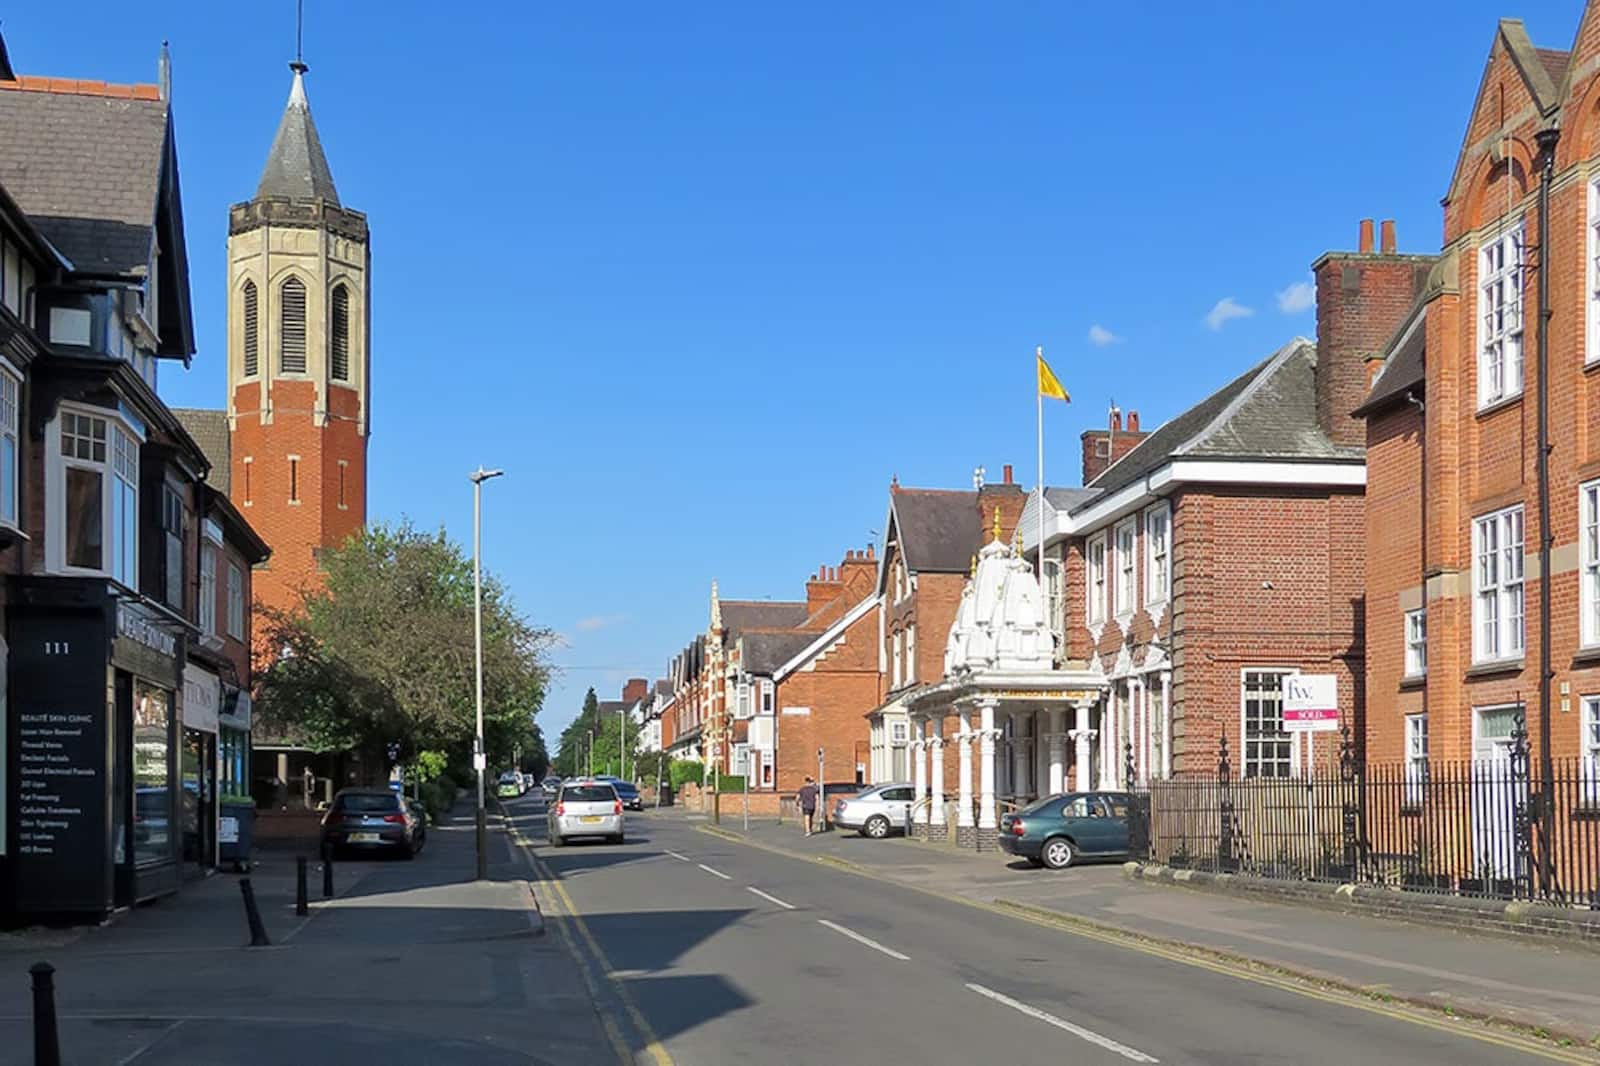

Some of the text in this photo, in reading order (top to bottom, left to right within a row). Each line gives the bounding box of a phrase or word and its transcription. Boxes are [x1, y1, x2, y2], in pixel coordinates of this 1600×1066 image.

[45, 642, 69, 654] 111
[21, 714, 48, 722] BEAUTÉ
[54, 728, 82, 736] Removal
[47, 754, 70, 762] Facials
[73, 768, 96, 776] Facials
[36, 820, 69, 829] Tightening
